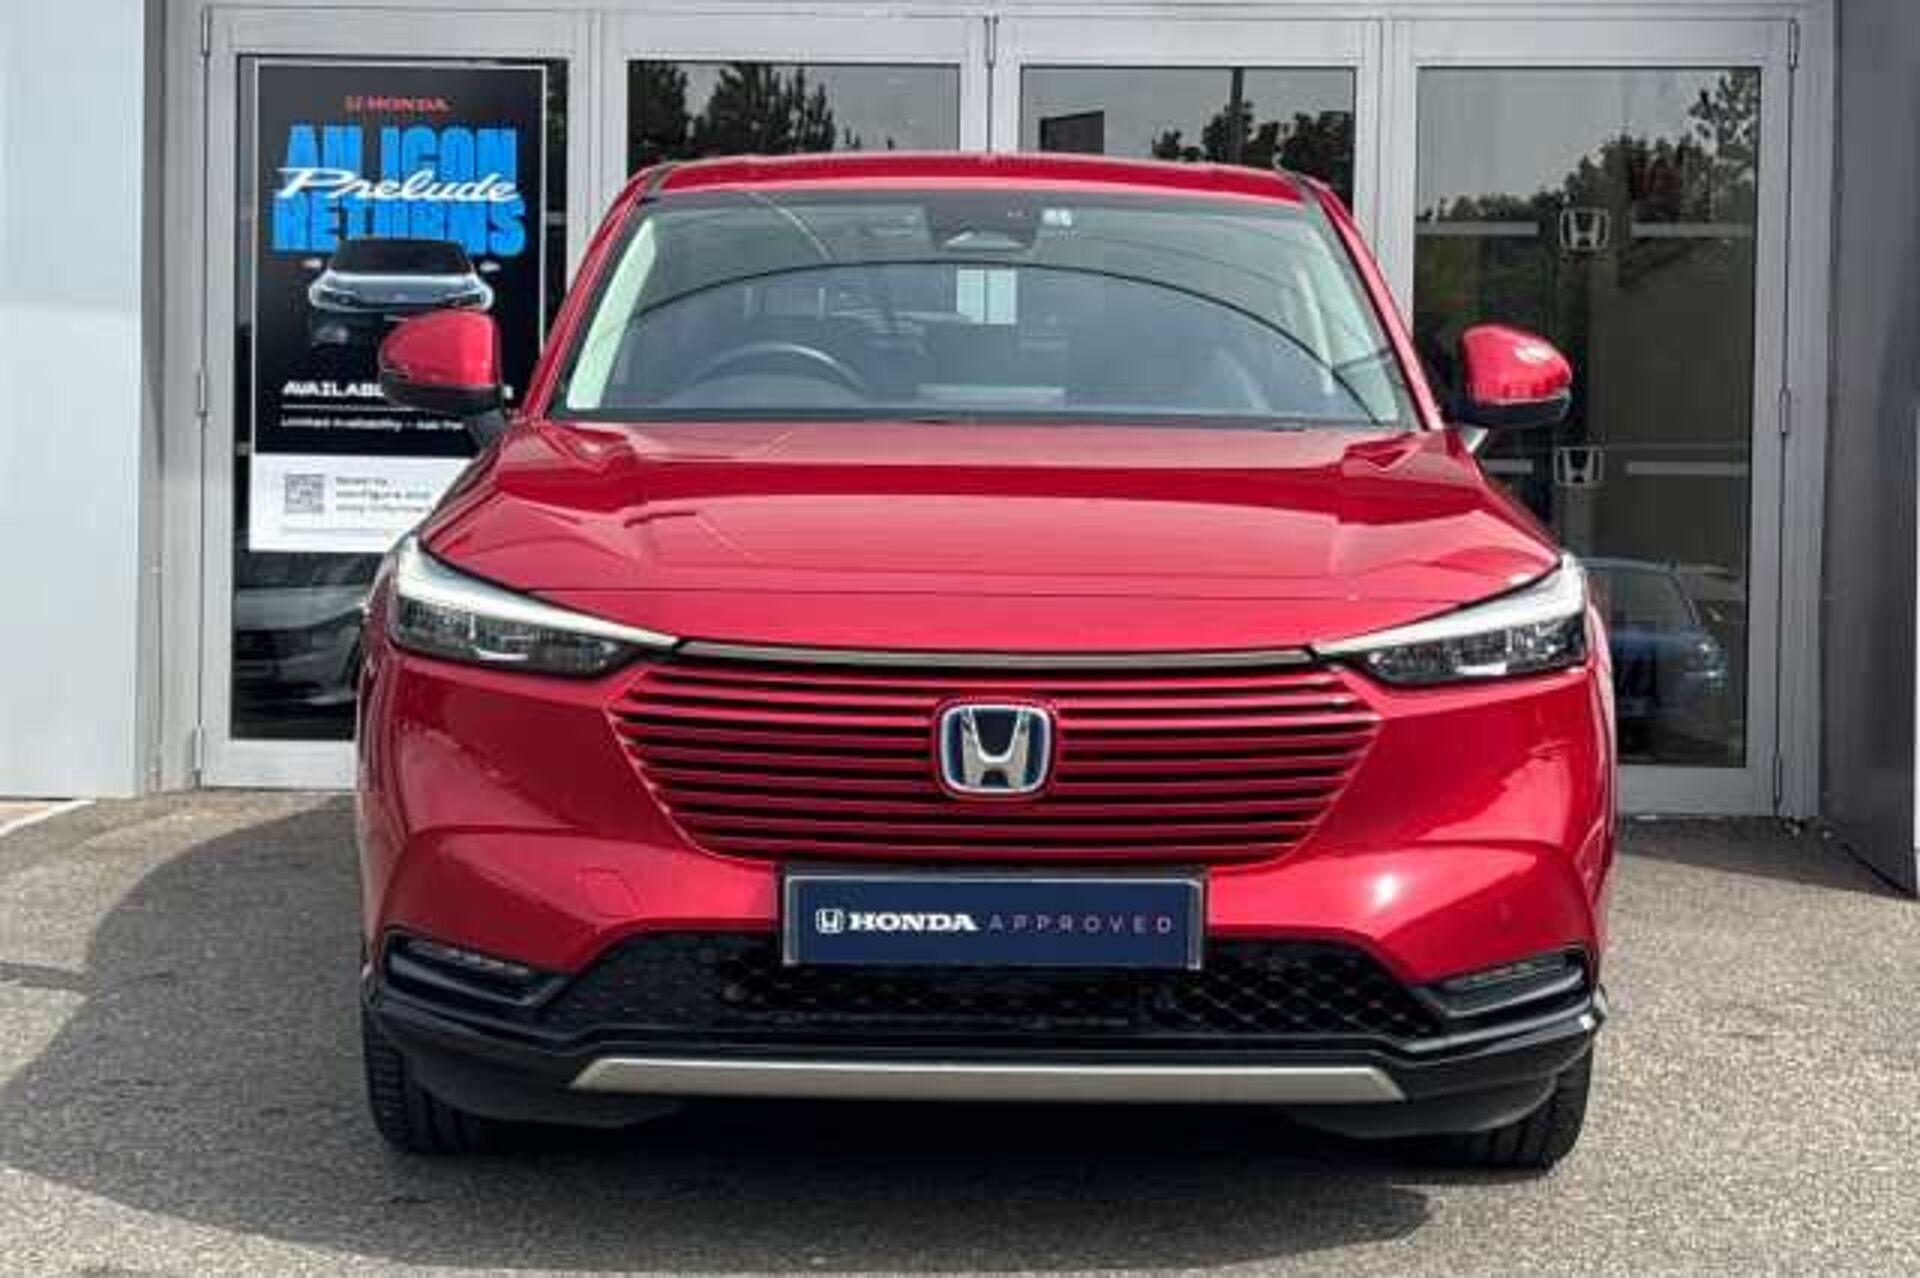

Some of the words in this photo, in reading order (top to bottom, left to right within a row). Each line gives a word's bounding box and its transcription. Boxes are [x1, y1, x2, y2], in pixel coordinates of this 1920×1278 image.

[367, 96, 450, 112] HONDA
[380, 125, 518, 188] ICON
[276, 167, 521, 201] Prelude
[272, 189, 526, 257] RETURNS
[282, 380, 385, 398] AVAILABL
[848, 911, 979, 932] HONDA
[988, 913, 1173, 935] APPROVED
